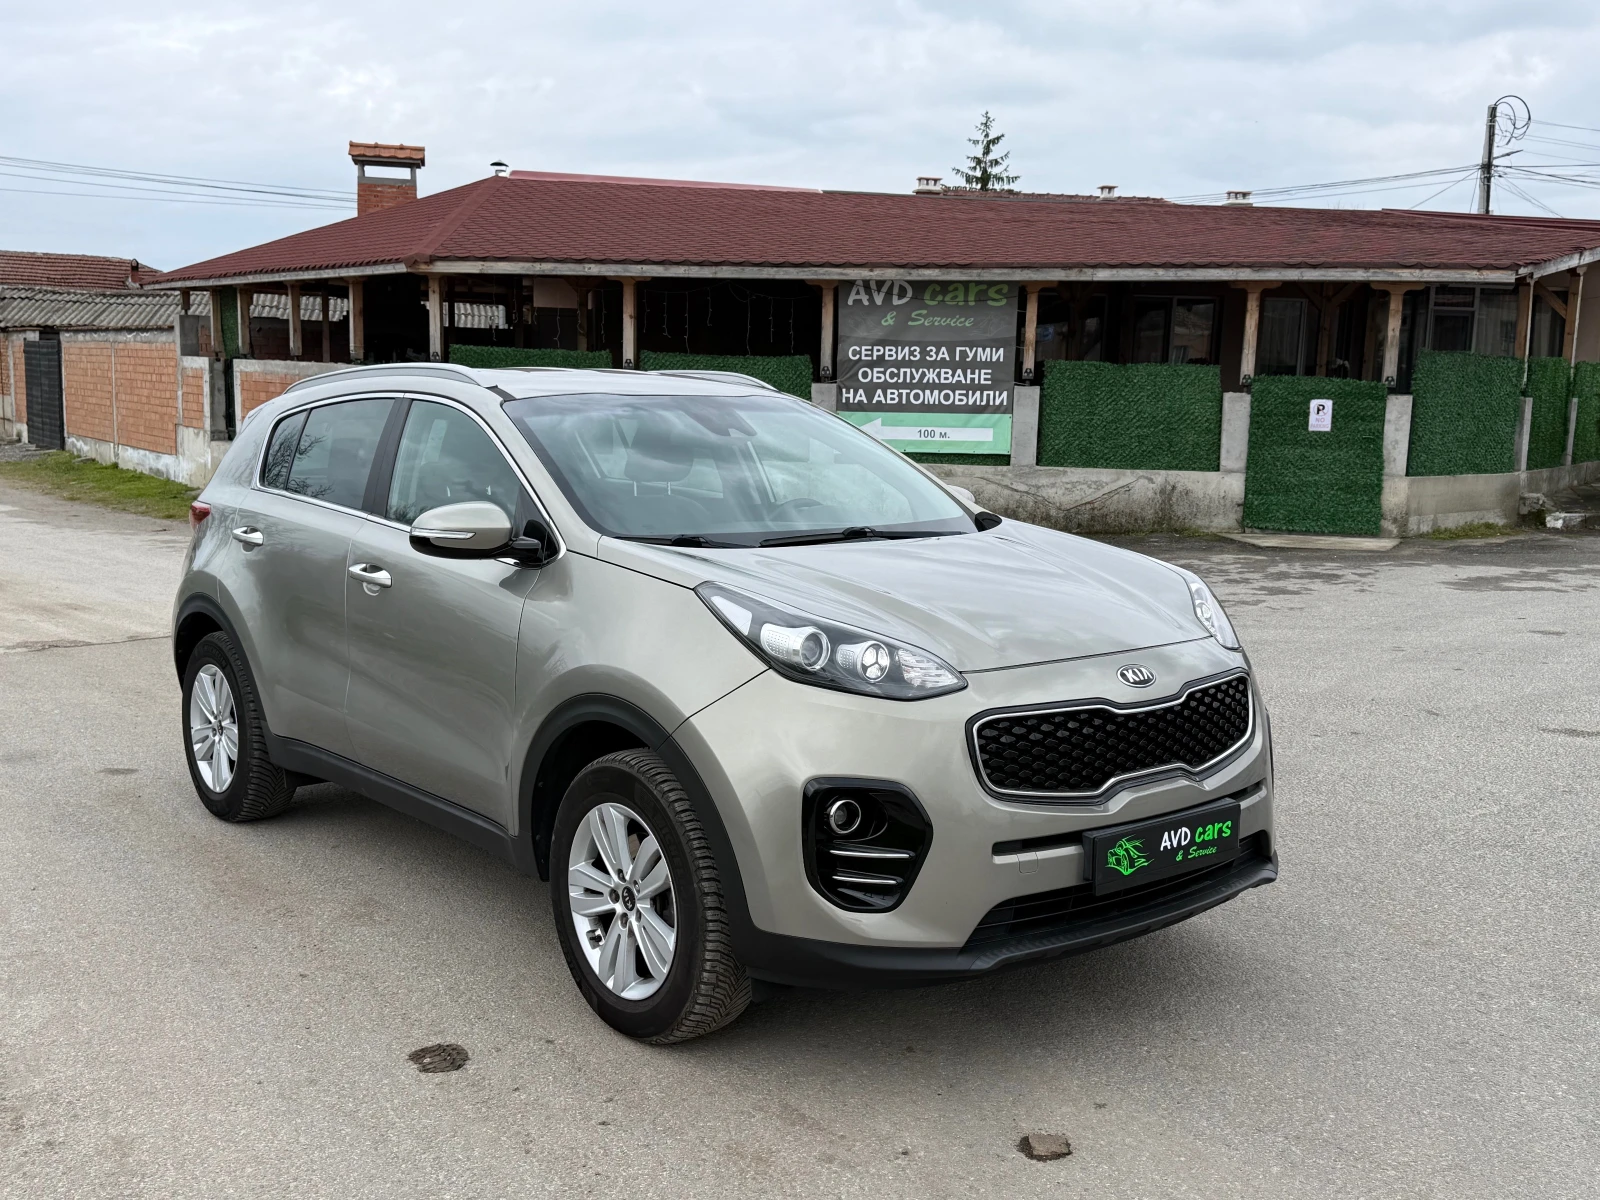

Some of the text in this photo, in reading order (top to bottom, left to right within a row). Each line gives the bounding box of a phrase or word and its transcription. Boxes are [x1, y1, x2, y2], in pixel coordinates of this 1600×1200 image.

[847, 280, 1009, 307] AVD cars
[881, 309, 974, 327] & Service
[848, 345, 1004, 362] СЕРВИЗ ЗА ГУМИ
[857, 367, 992, 384] ОБСЛУЖВАНЕ
[842, 388, 1008, 405] НА АВТОМОБИЛИ
[917, 429, 950, 439] 100 м.
[1122, 667, 1153, 682] KIA
[1160, 820, 1232, 851] AVD cars
[1175, 845, 1217, 862] & Service
